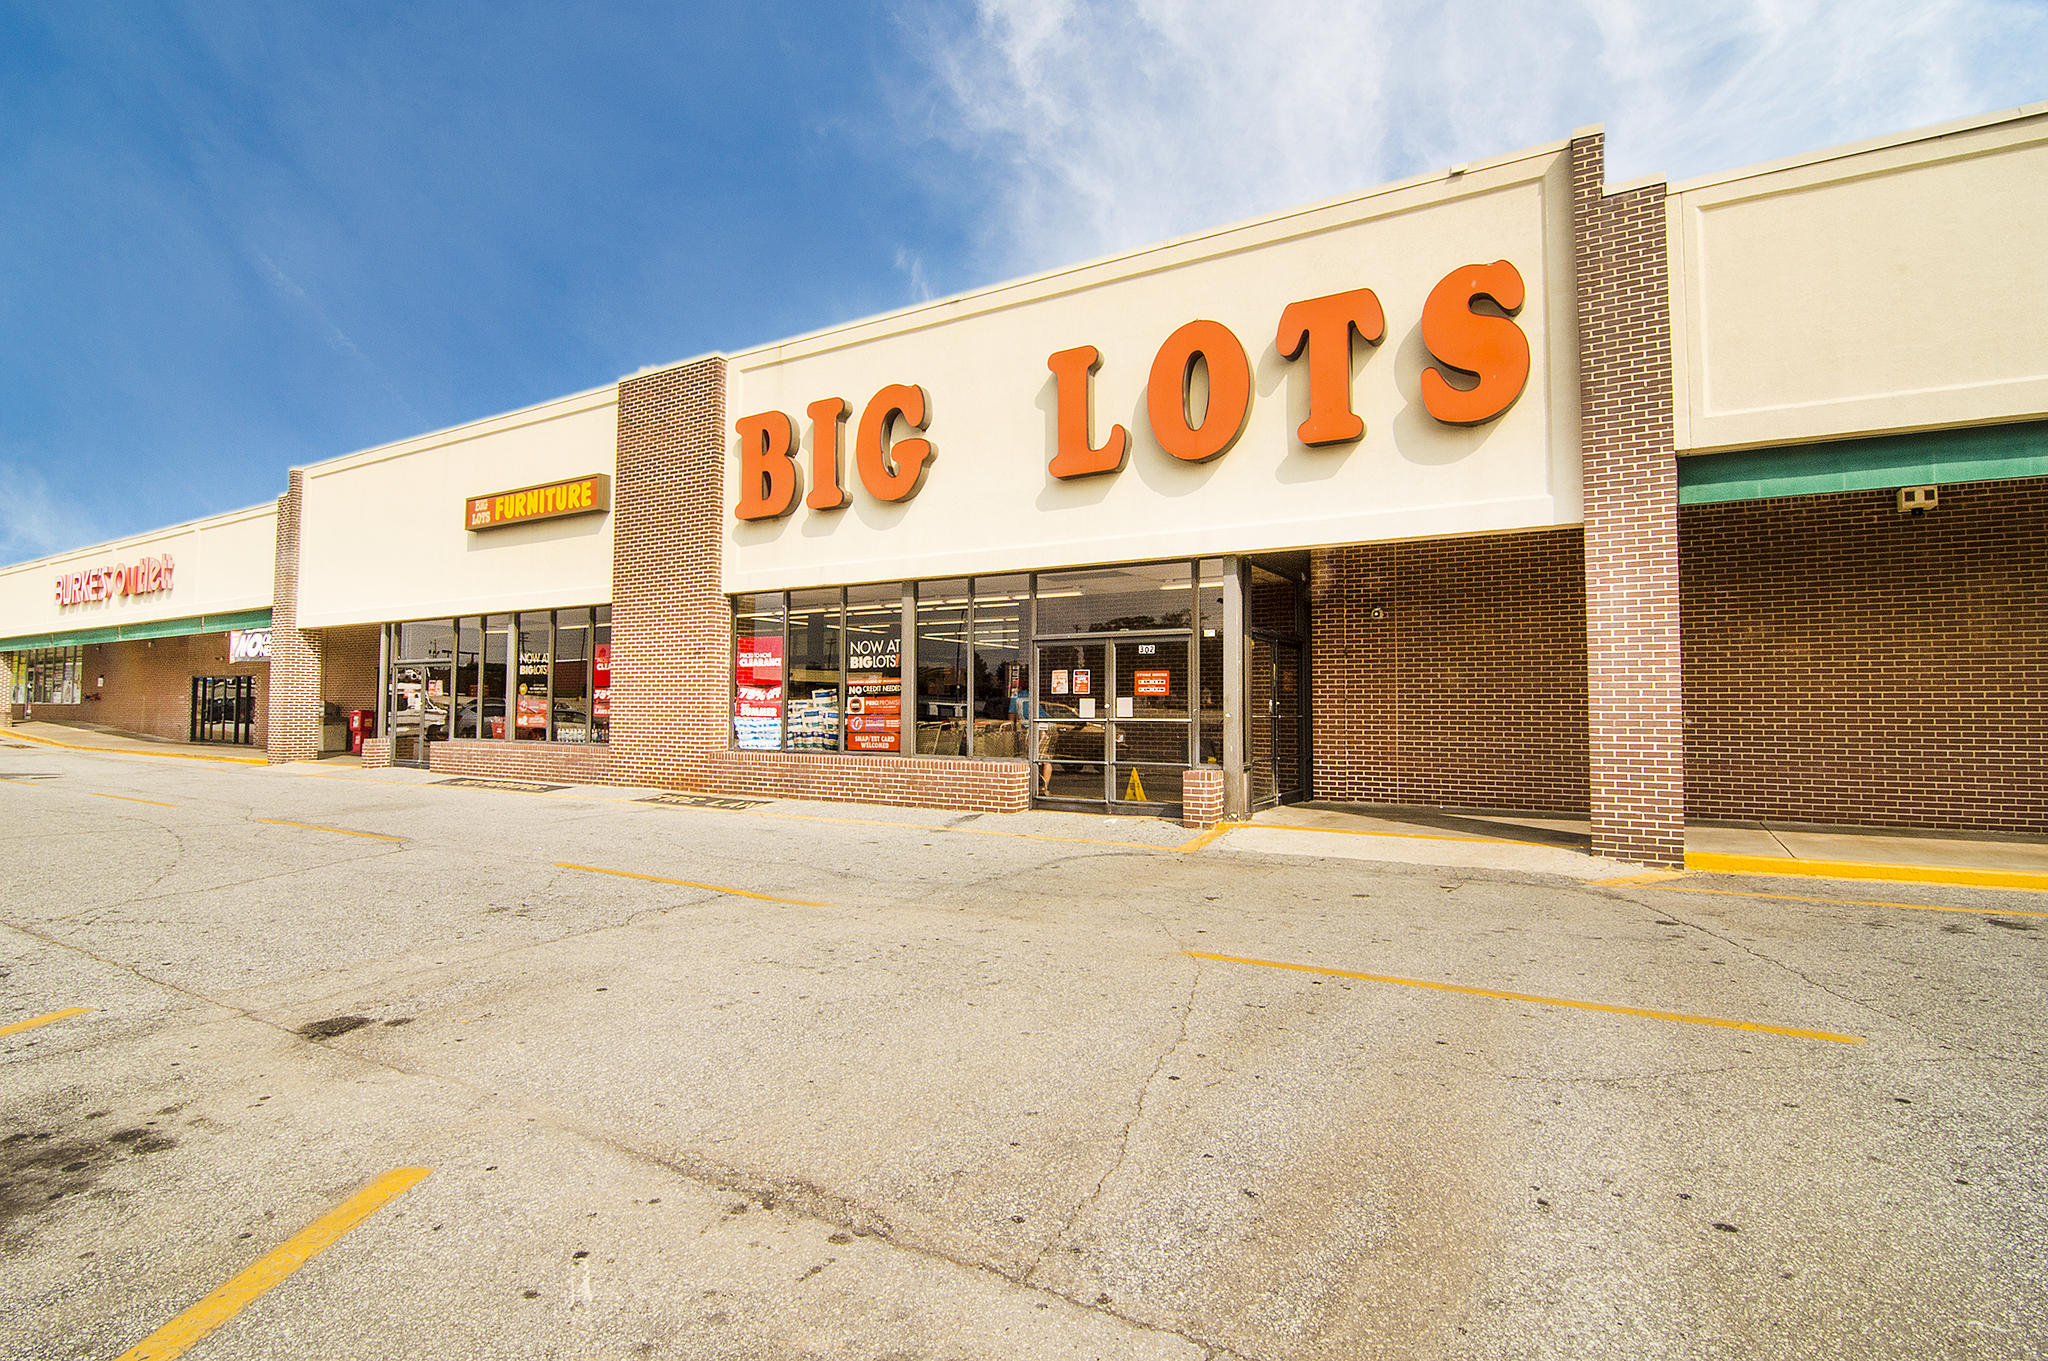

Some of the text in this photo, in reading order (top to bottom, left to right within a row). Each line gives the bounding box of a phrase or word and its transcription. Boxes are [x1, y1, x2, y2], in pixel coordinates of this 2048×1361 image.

[735, 260, 1530, 521] BIG LOTS
[475, 480, 592, 521] BIG FURNITURE
[471, 511, 491, 525] LOTS
[113, 553, 175, 597] Outlet
[850, 639, 901, 655] NOW AT
[1139, 644, 1155, 654] 302
[519, 652, 541, 664] NOW
[739, 657, 782, 667] CLEARANCE
[848, 685, 863, 695] NO
[863, 685, 881, 693] CREDIT
[880, 735, 895, 743] CARD
